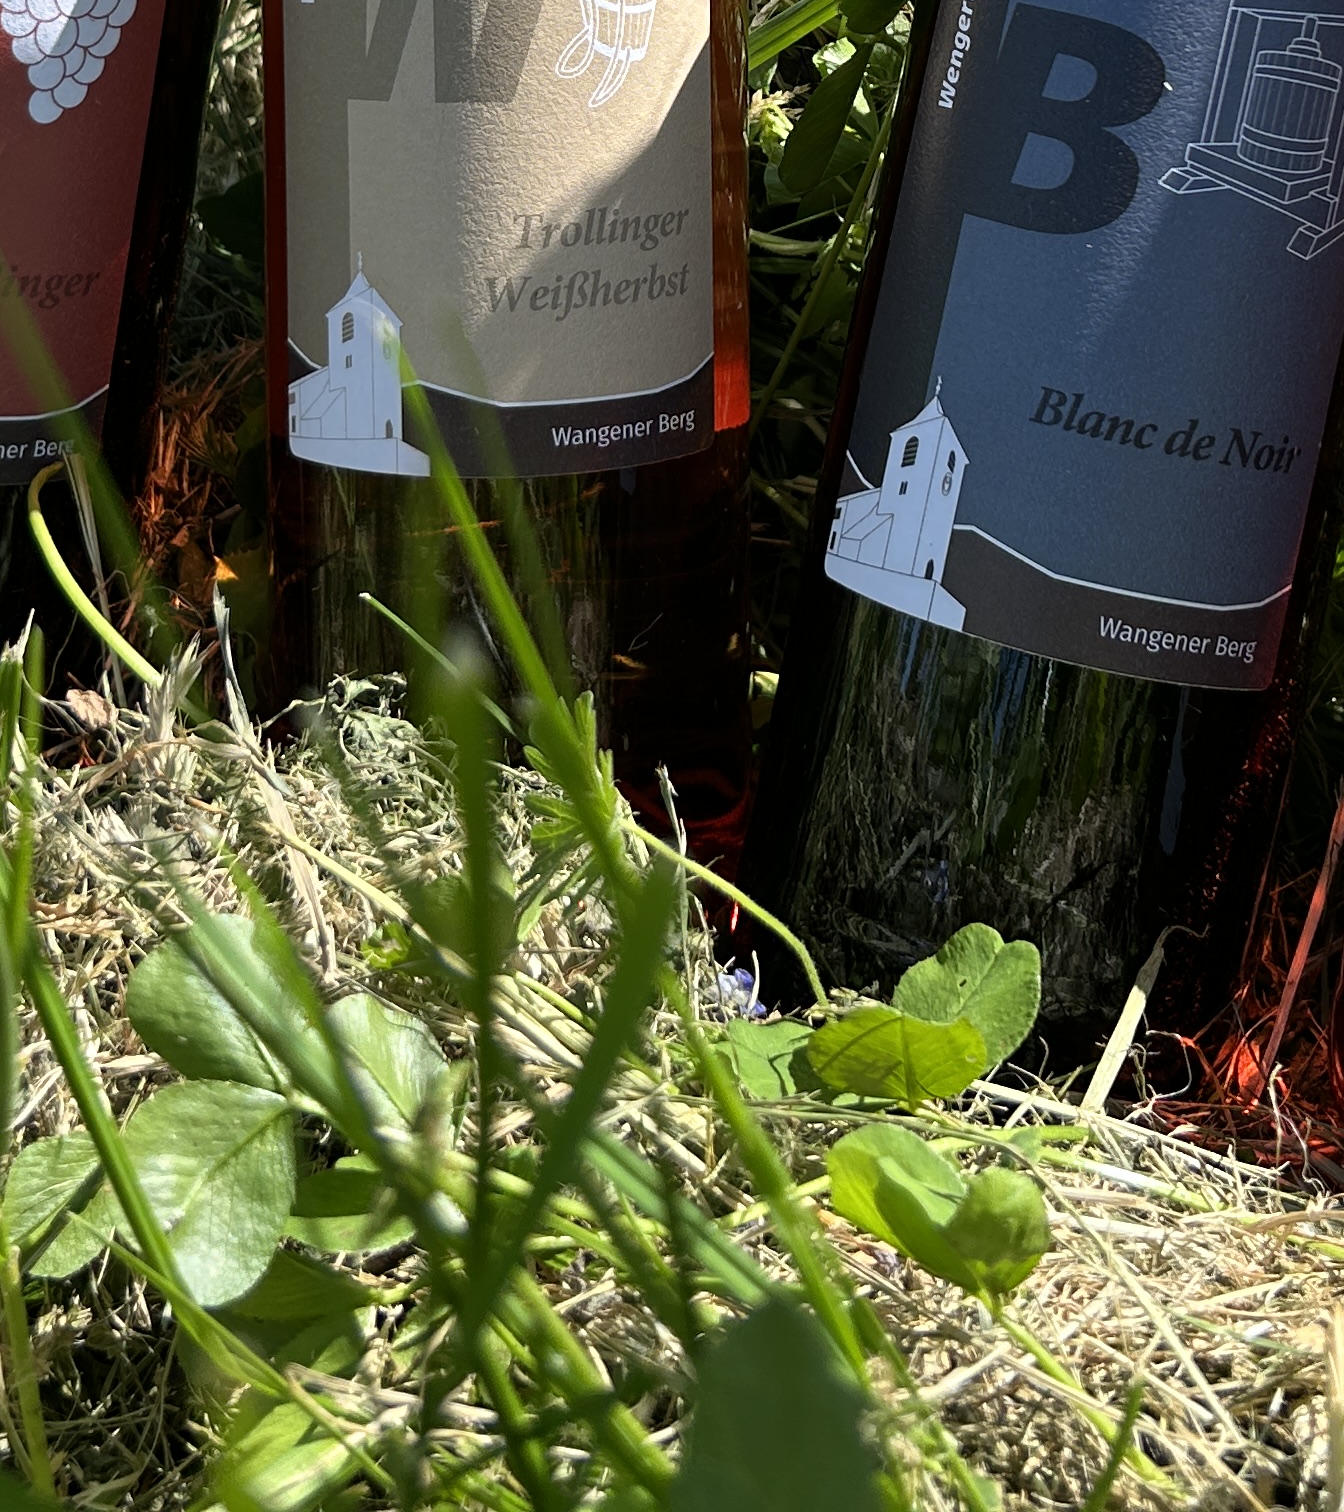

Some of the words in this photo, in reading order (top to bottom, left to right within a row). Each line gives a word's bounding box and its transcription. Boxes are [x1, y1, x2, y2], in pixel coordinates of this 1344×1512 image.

[961, 2, 1167, 236] B
[513, 206, 690, 252] Trollinger
[483, 262, 690, 322] Weißherbst
[551, 418, 654, 448] Wangener
[658, 409, 696, 433] Berg
[1028, 385, 1159, 451] Blanc
[1163, 398, 1217, 462] de
[1218, 427, 1303, 475] Noir
[1098, 615, 1212, 655] Wangener
[1214, 635, 1258, 665] Berg
